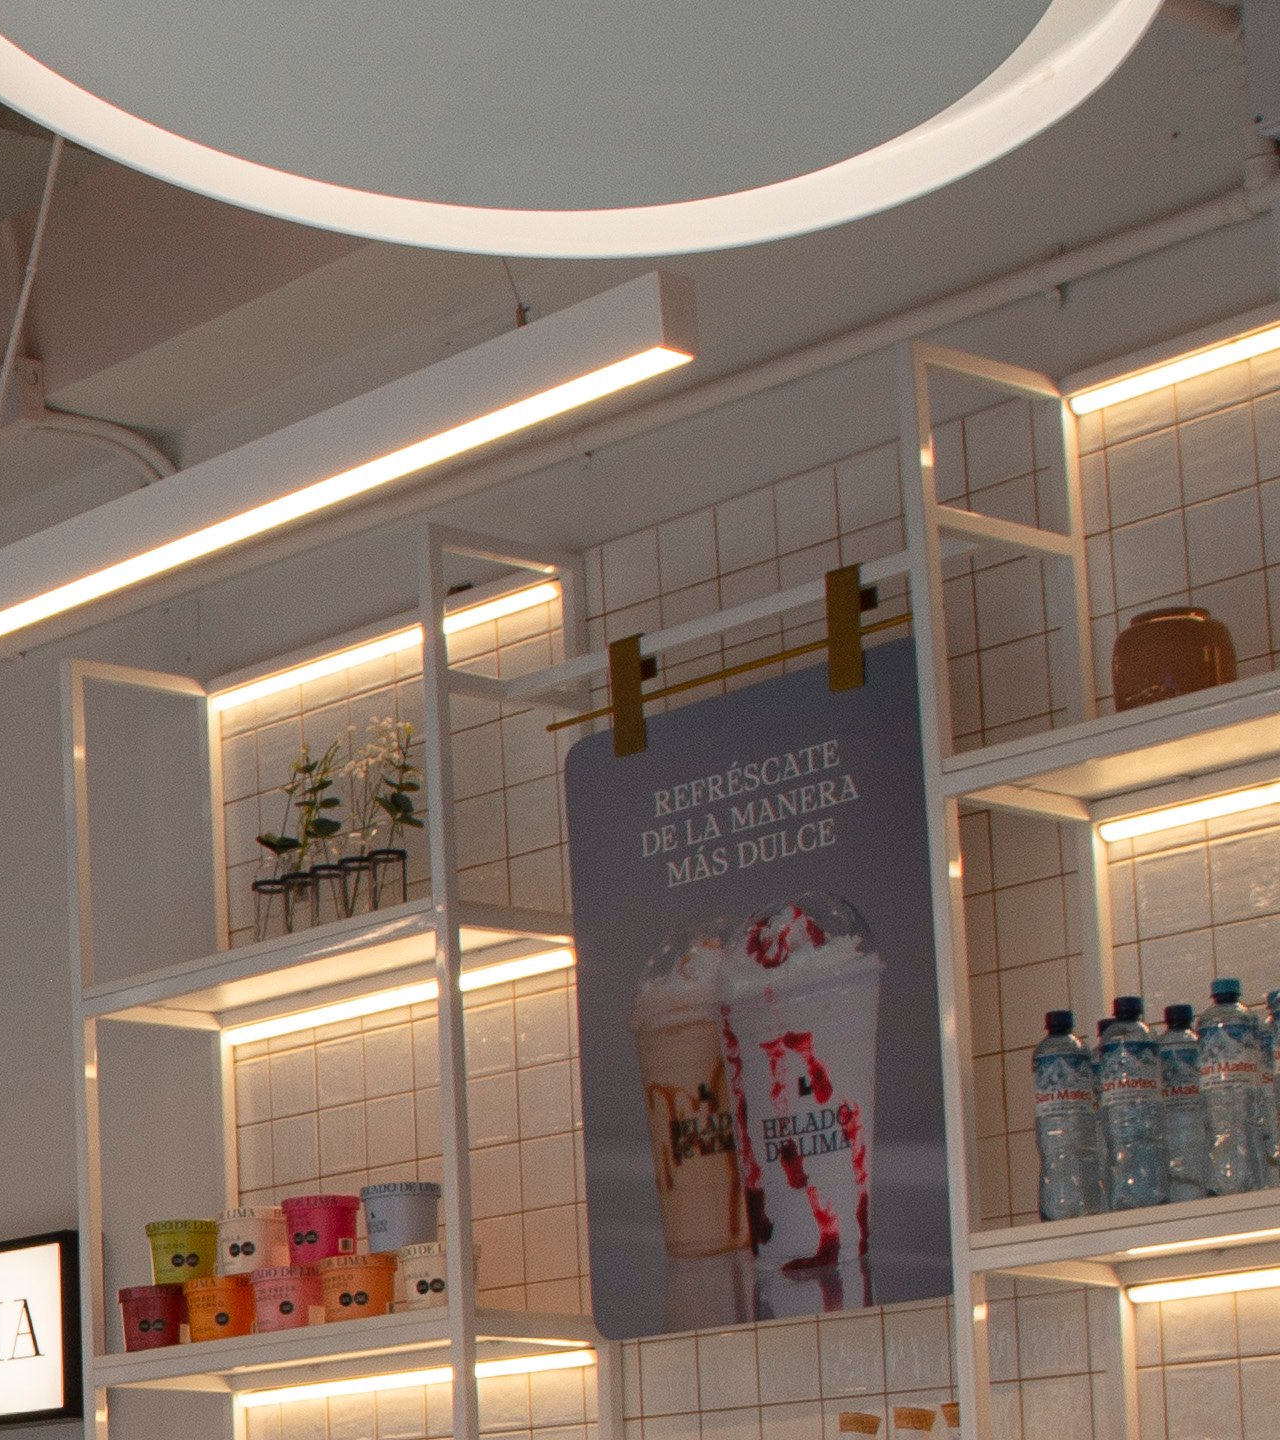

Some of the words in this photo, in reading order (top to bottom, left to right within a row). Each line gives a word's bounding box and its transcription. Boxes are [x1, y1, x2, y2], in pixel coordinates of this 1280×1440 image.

[654, 739, 840, 818] REFRÉSCATE
[641, 824, 679, 858] DE
[685, 813, 723, 845] LA
[730, 774, 859, 833] MANERA
[666, 845, 729, 888] MÁS
[737, 818, 837, 869] DULCE
[761, 1103, 853, 1140] HELADO
